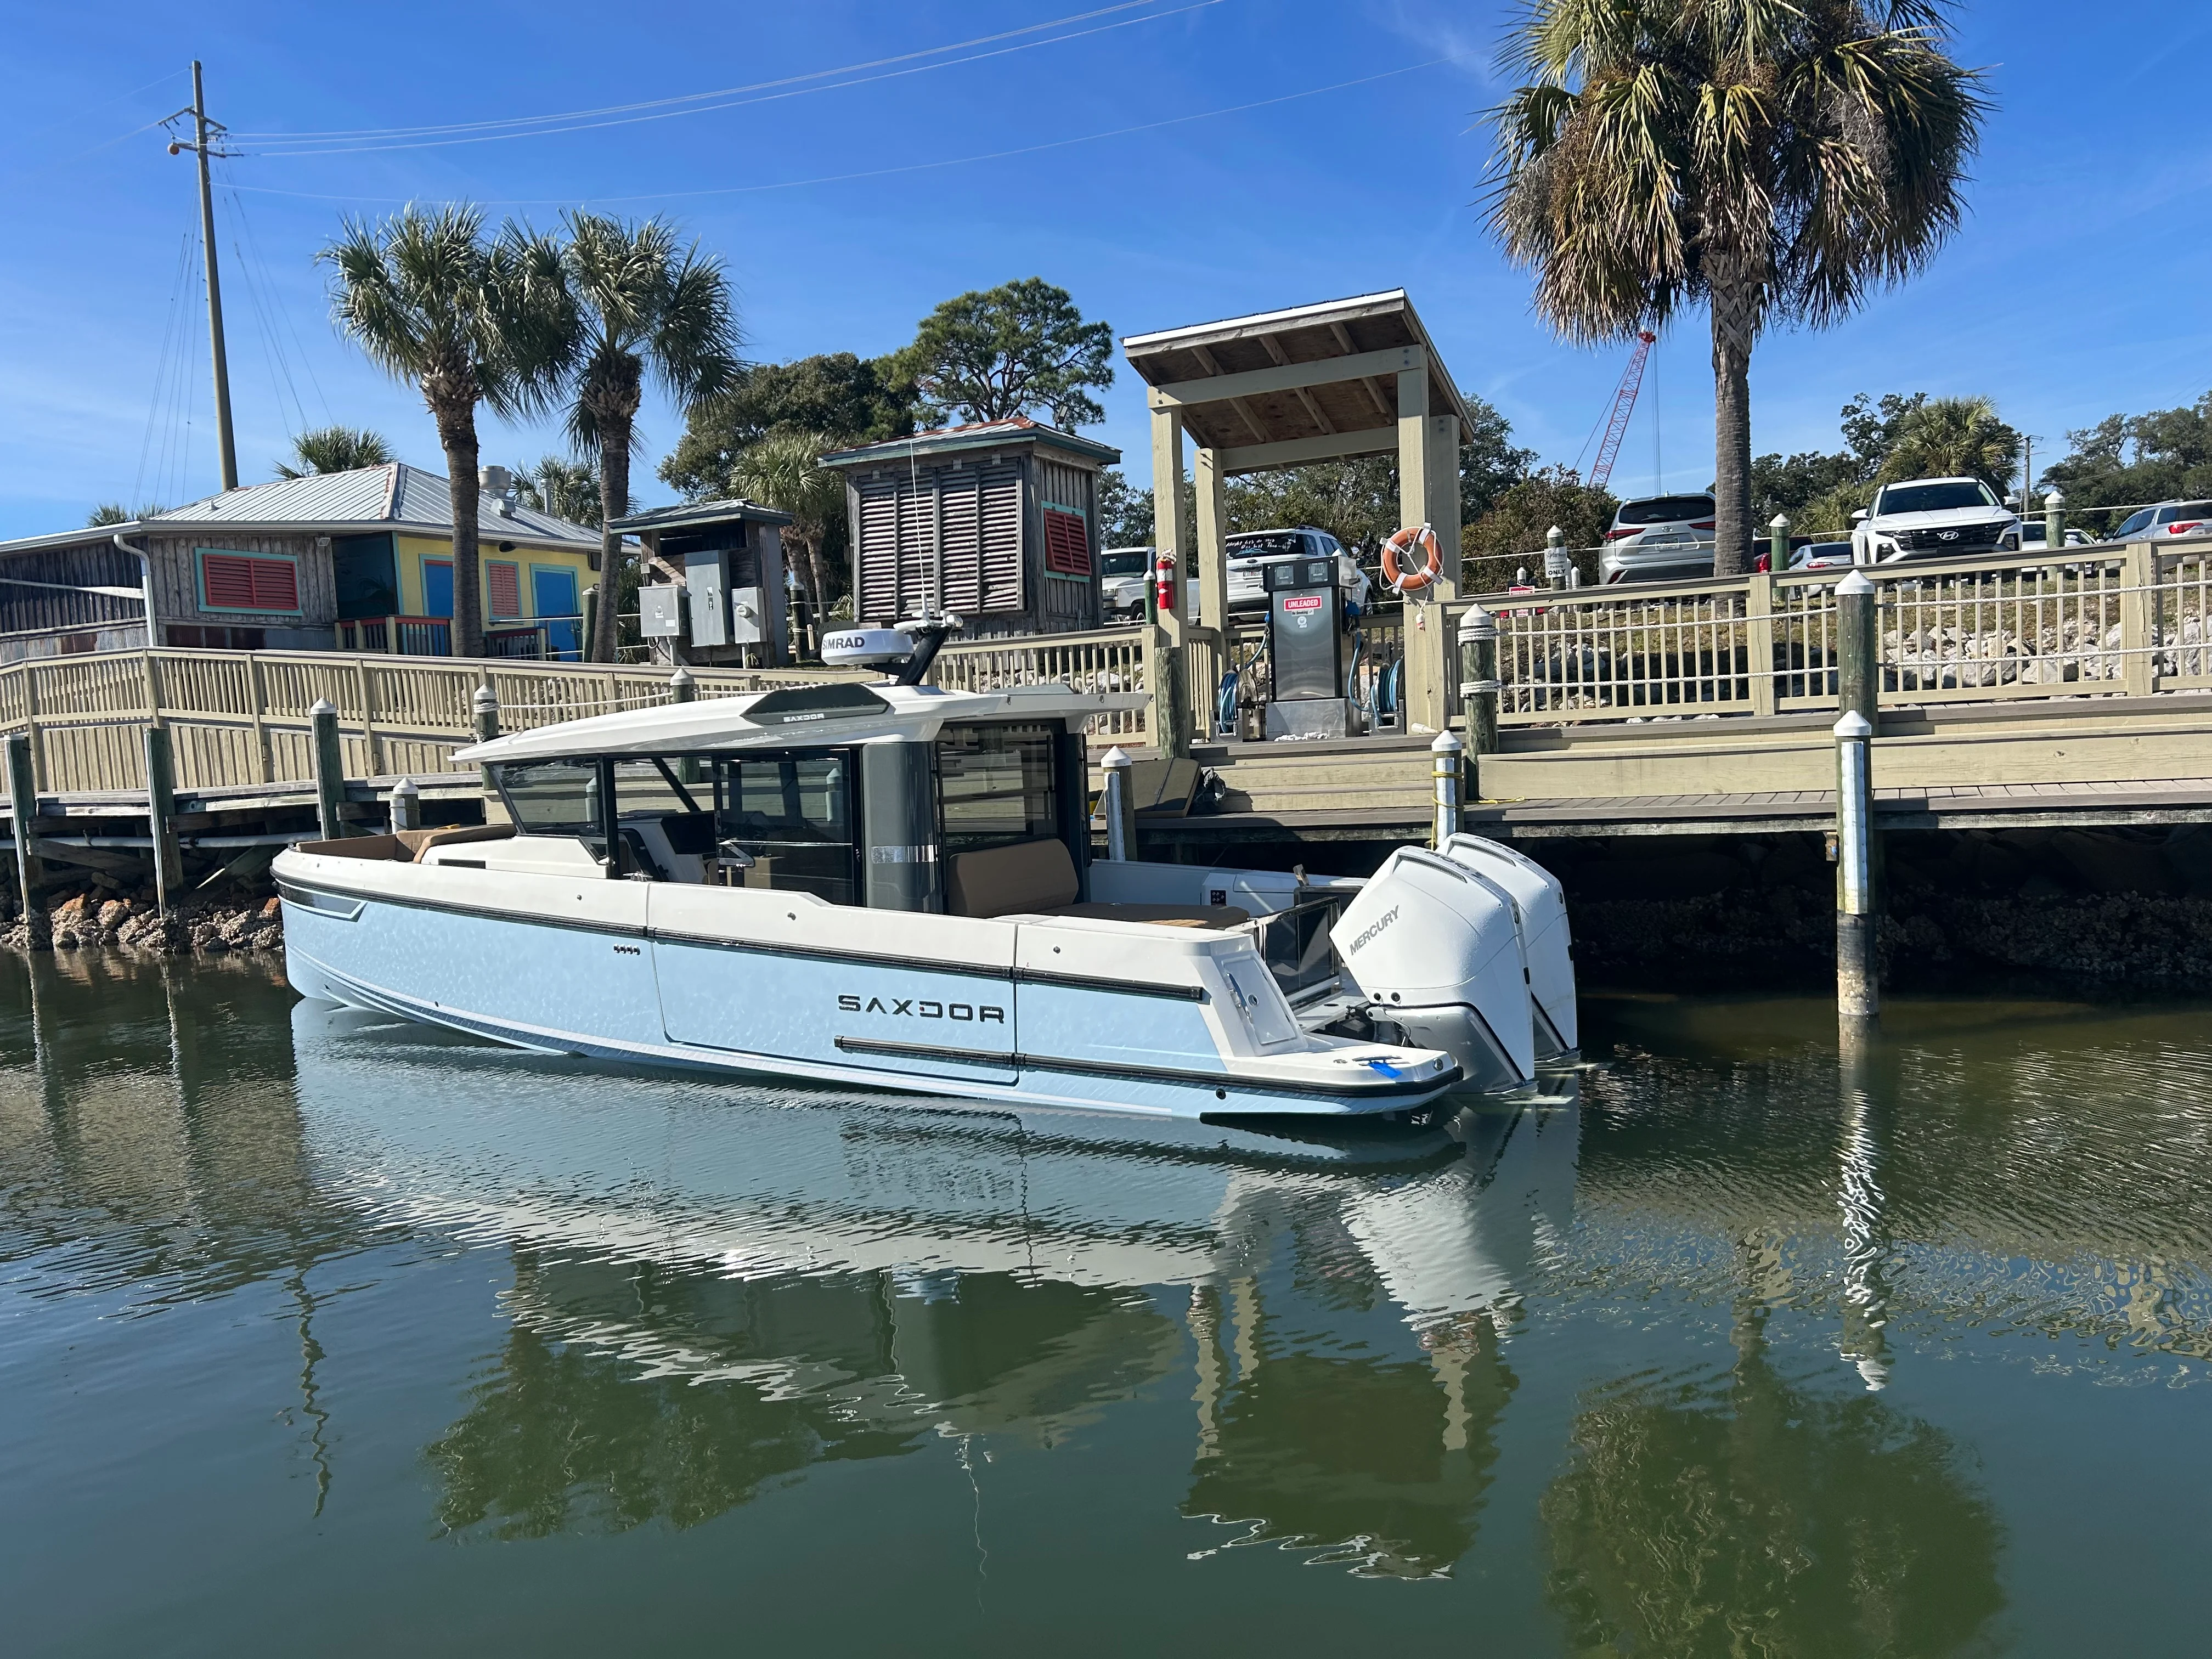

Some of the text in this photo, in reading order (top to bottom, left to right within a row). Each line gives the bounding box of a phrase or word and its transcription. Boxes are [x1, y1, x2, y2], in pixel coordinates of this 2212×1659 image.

[1288, 599, 1318, 608] UNLEADED
[783, 714, 825, 722] SAXDOR
[1350, 905, 1399, 956] MERCURY
[838, 994, 1005, 1024] SAXDOR
